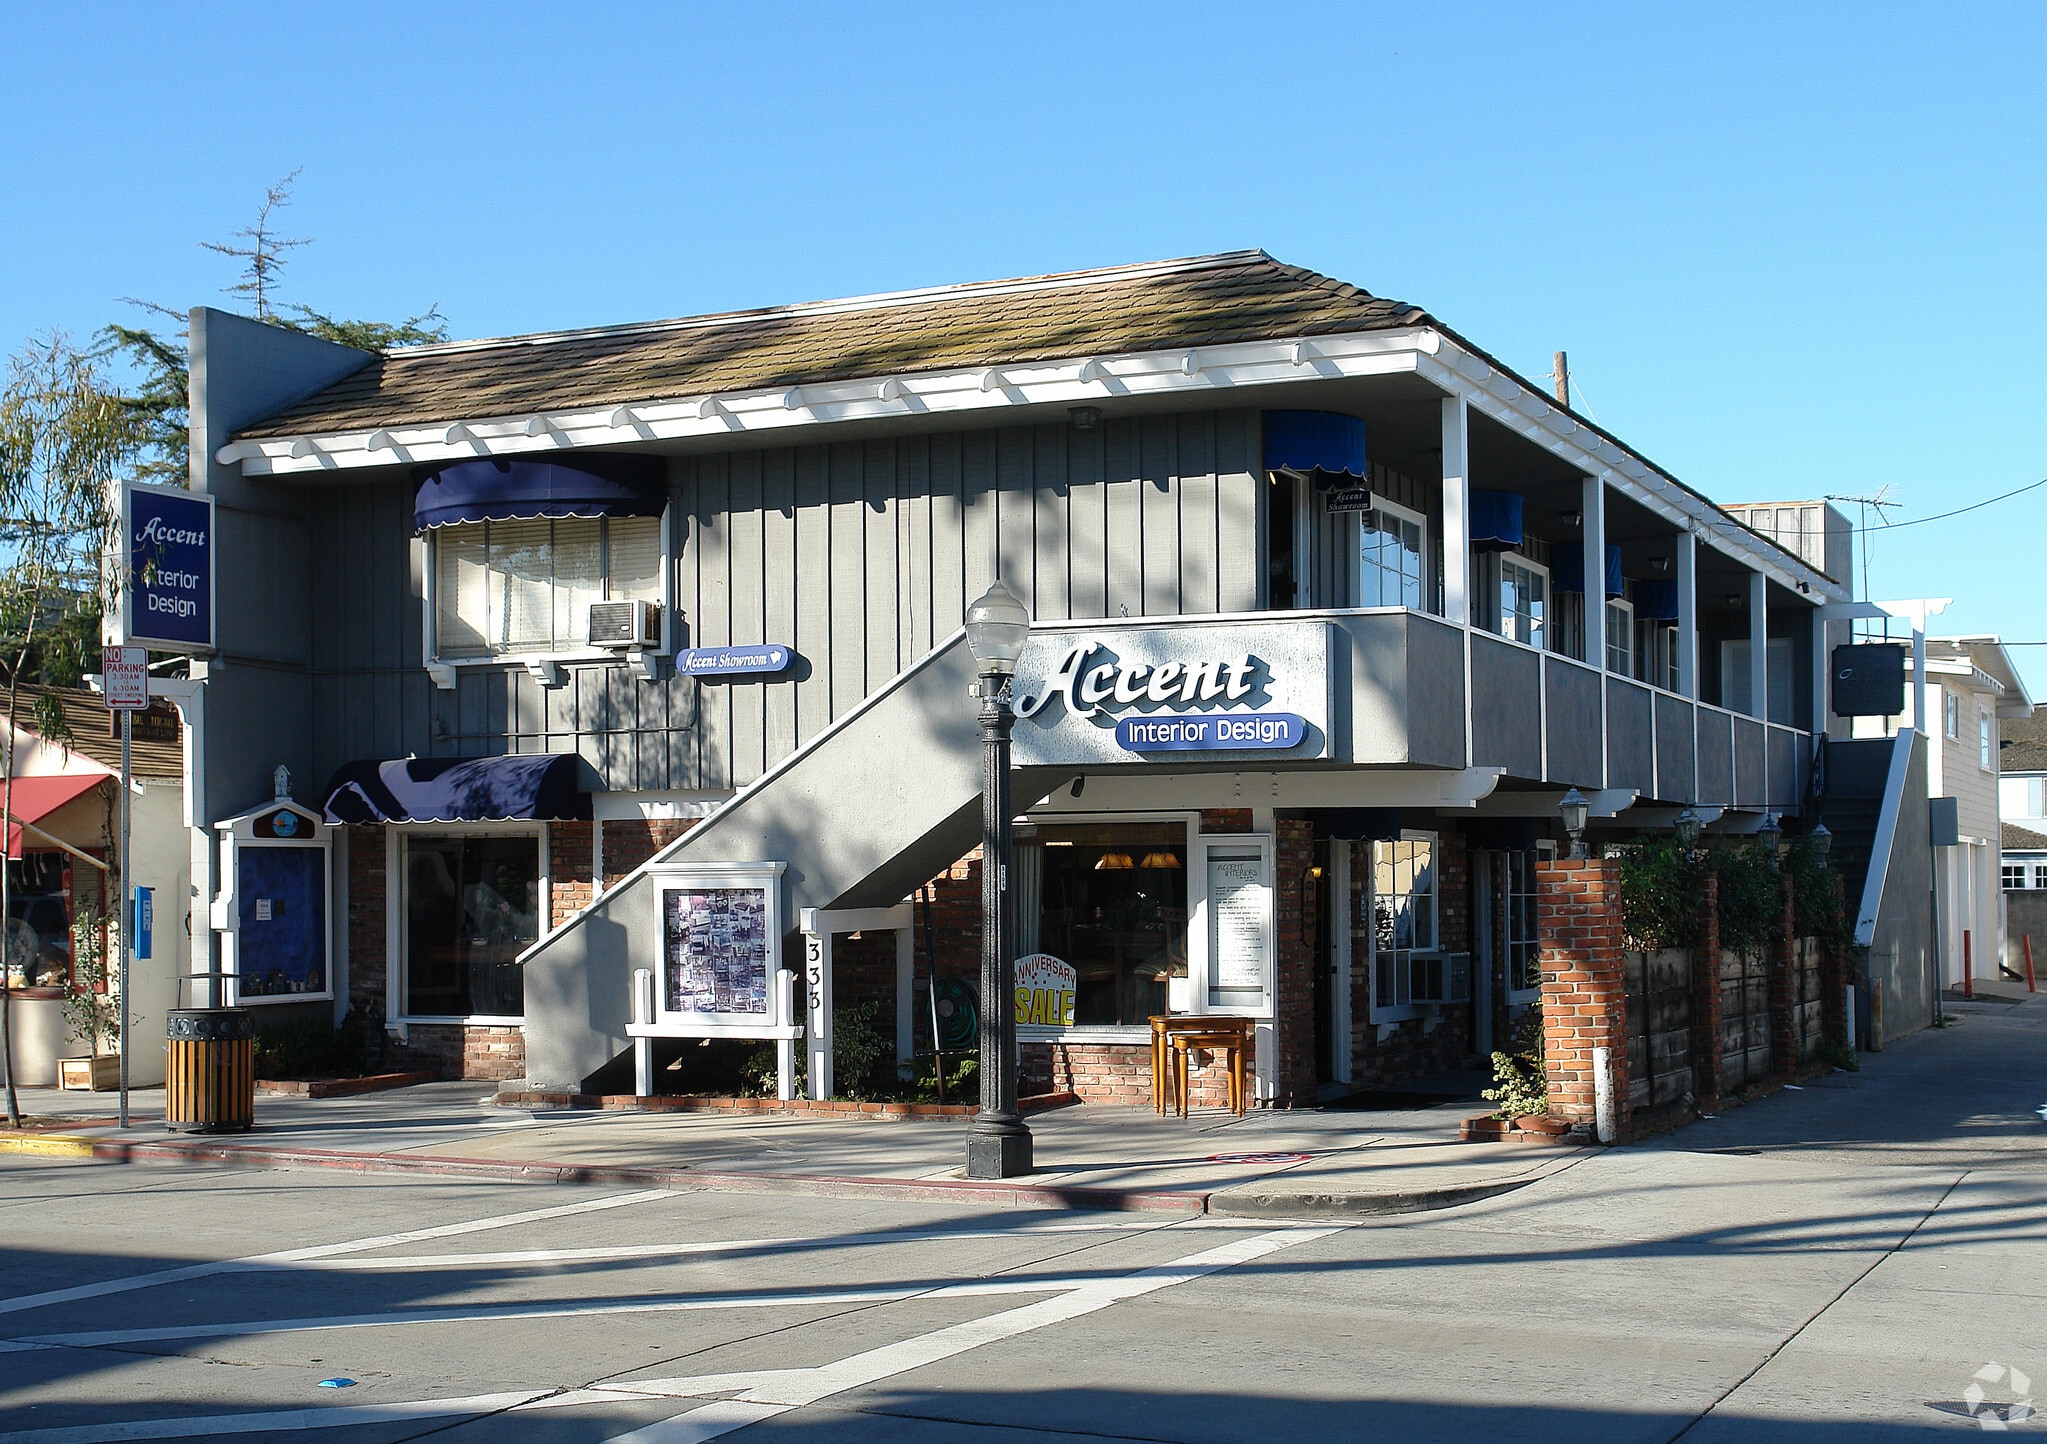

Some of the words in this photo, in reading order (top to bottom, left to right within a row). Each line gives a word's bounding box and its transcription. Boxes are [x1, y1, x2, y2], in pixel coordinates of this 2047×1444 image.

[1328, 502, 1369, 511] Showroom
[1333, 491, 1363, 503] Accent
[136, 516, 206, 546] Accent
[147, 567, 200, 590] terior
[148, 593, 196, 617] Design
[105, 648, 121, 662] NO
[682, 651, 717, 672] Accent
[718, 652, 767, 669] Showroom
[106, 663, 144, 673] PARKING
[1012, 640, 1256, 719] Accent
[1128, 720, 1208, 743] Interior
[1216, 717, 1289, 743] Design
[1013, 956, 1076, 988] ANNIVERSARY
[1015, 986, 1075, 1027] SALE
